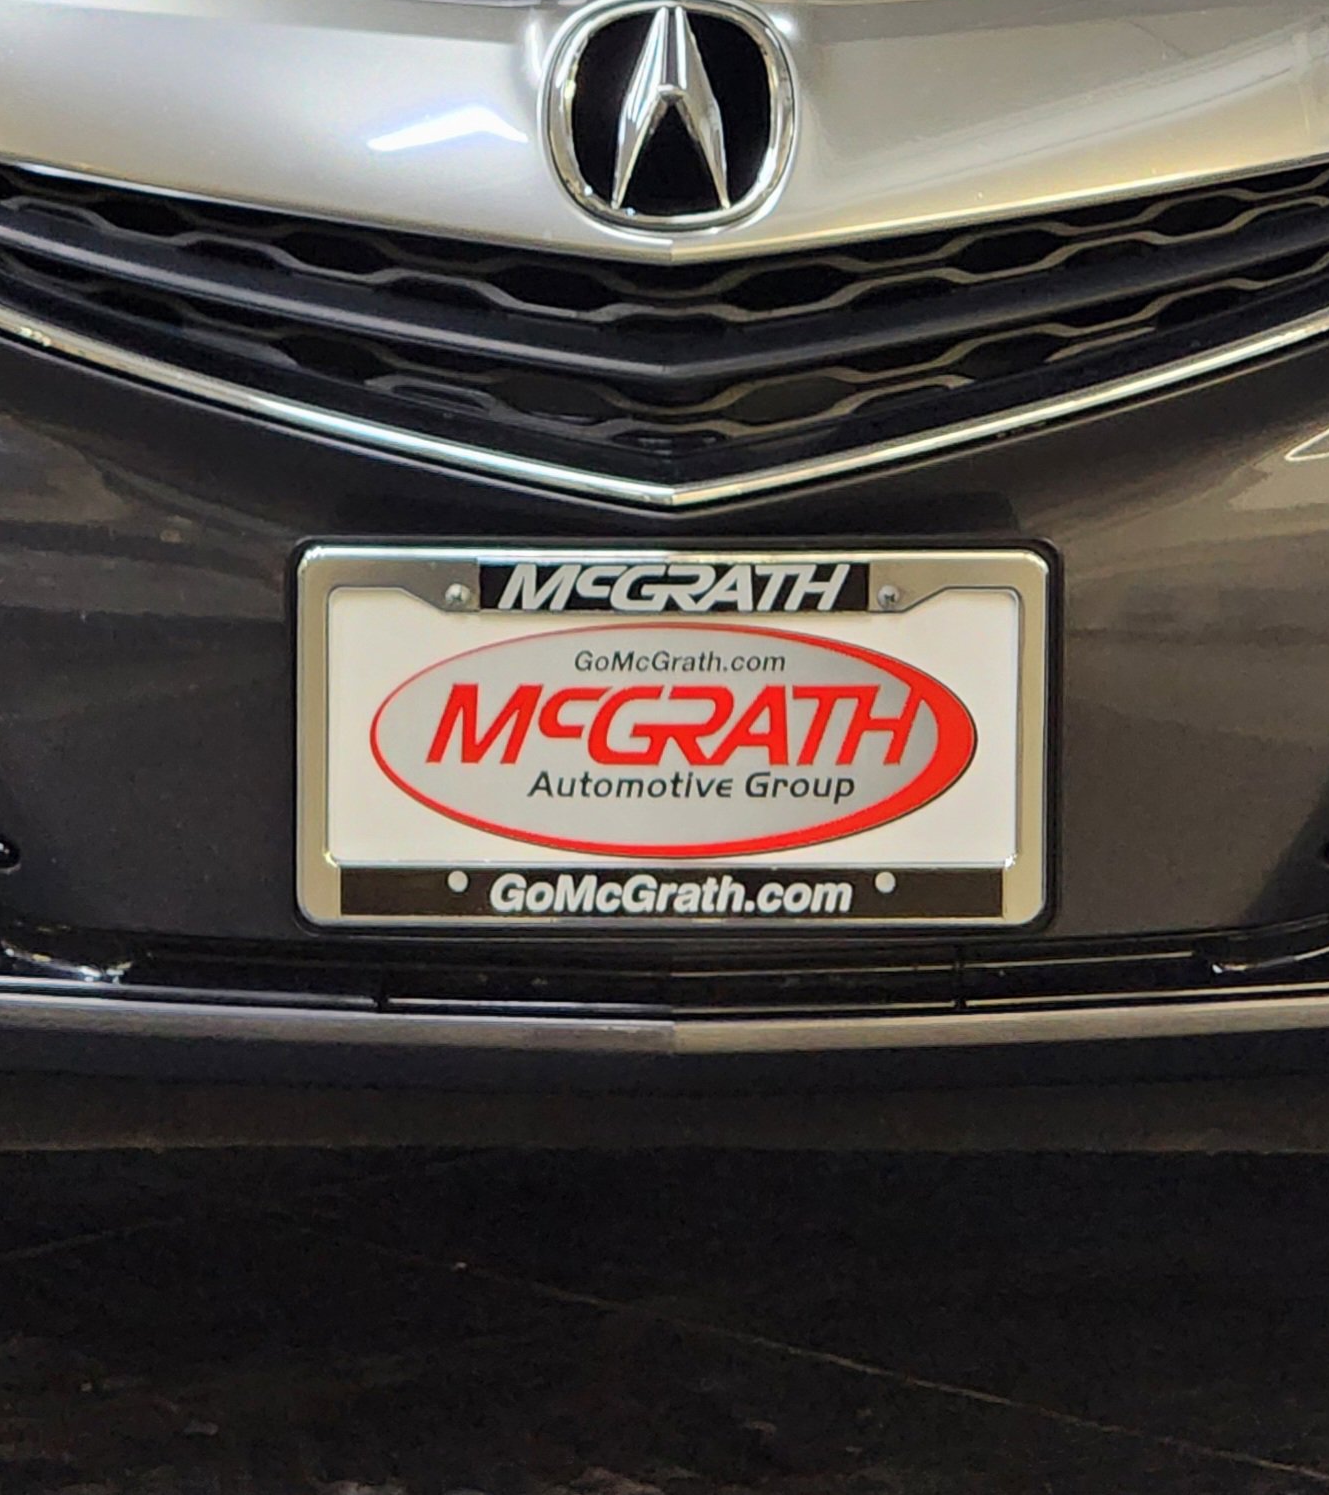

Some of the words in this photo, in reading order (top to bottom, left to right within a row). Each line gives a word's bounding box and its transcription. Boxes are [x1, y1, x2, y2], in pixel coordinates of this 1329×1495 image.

[574, 650, 786, 673] GoMcGrath.com
[528, 771, 733, 799] Automotive
[745, 772, 856, 804] Group
[490, 874, 853, 913] GoMcGrath.com
